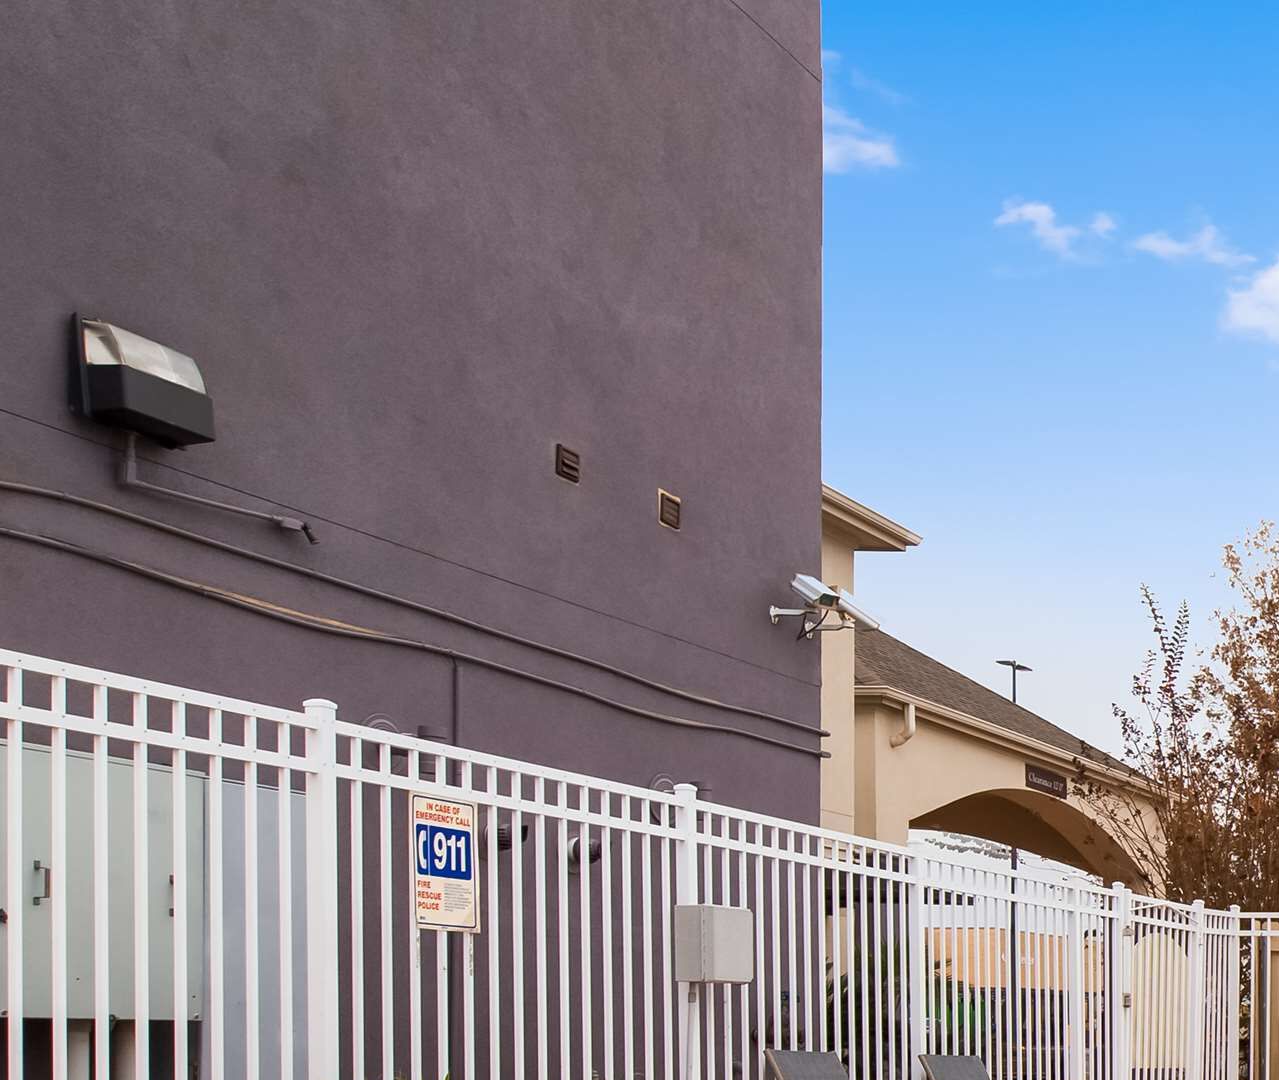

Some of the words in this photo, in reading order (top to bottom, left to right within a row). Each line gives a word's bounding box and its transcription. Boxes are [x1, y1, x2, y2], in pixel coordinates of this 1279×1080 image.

[426, 803, 434, 811] IN
[435, 804, 450, 814] CASE
[452, 806, 460, 815] OF
[416, 810, 454, 824] EMERGENCY
[455, 817, 470, 827] CALL
[433, 832, 467, 872] 911
[417, 880, 431, 889] FIRE
[417, 890, 442, 901] RESCUE
[417, 901, 440, 911] POLICE
